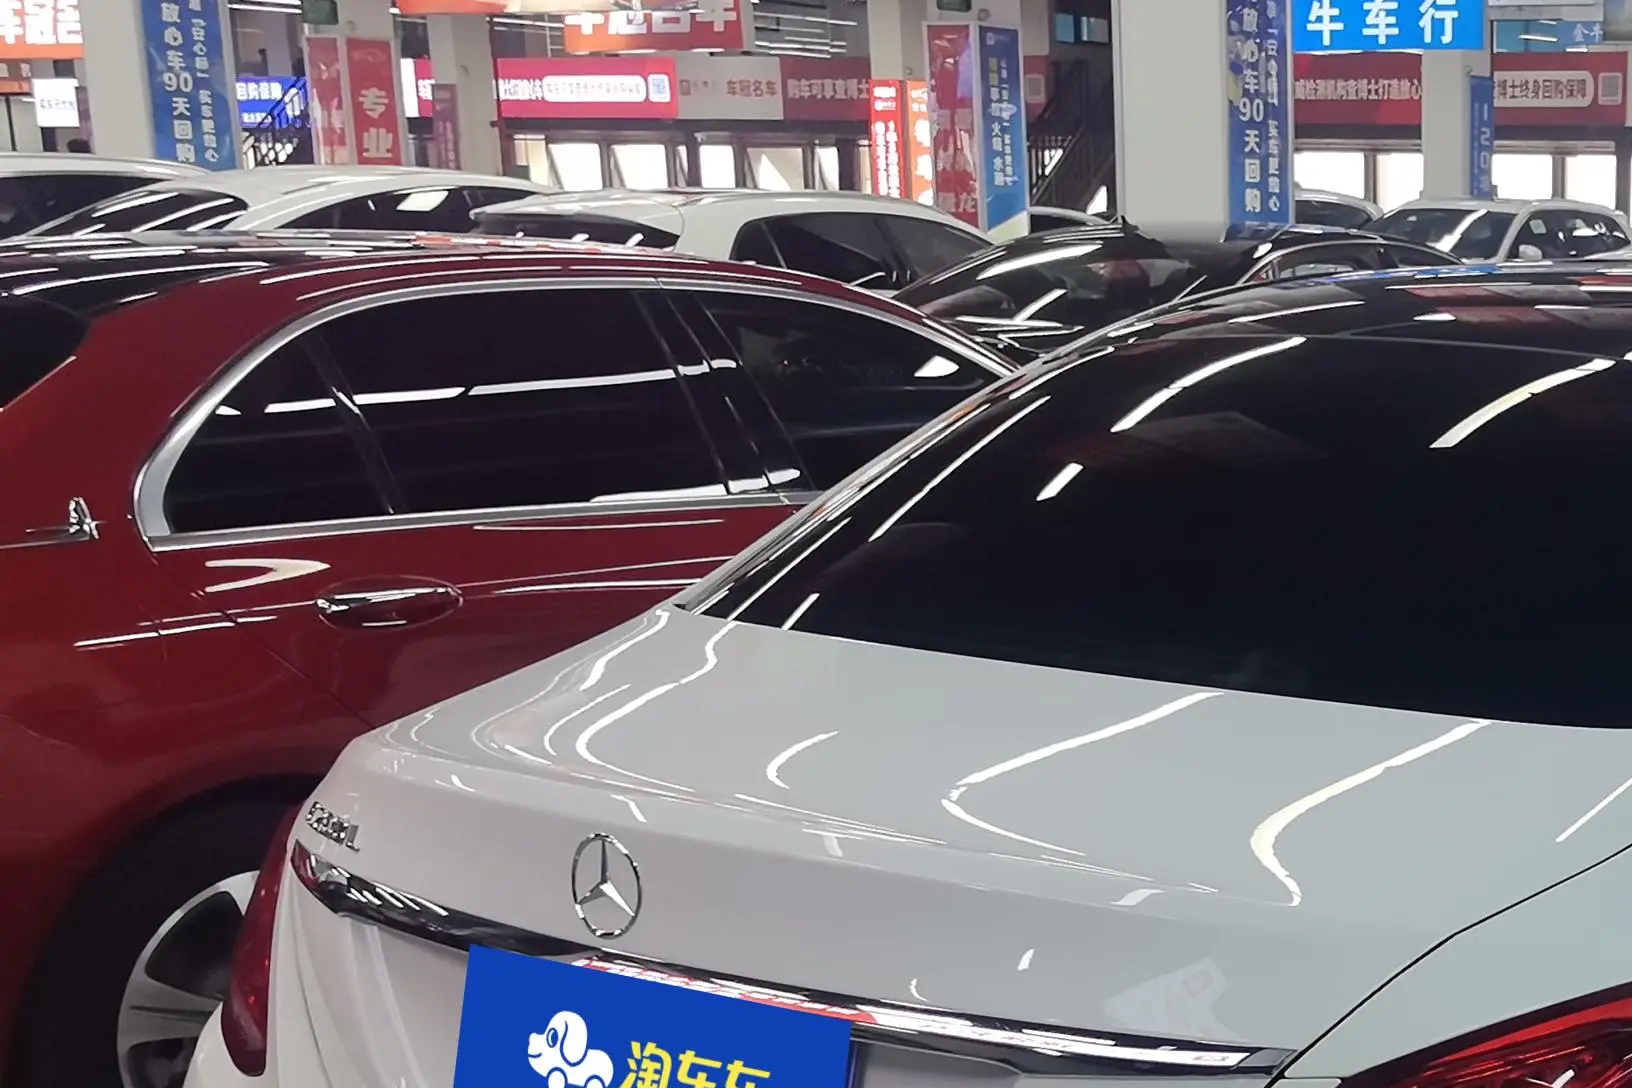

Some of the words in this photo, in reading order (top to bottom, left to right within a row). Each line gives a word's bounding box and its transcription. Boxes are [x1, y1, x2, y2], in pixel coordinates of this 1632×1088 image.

[1306, 0, 1459, 46] 牛车行
[726, 79, 778, 98] 车冠名车
[358, 87, 394, 158] 专业
